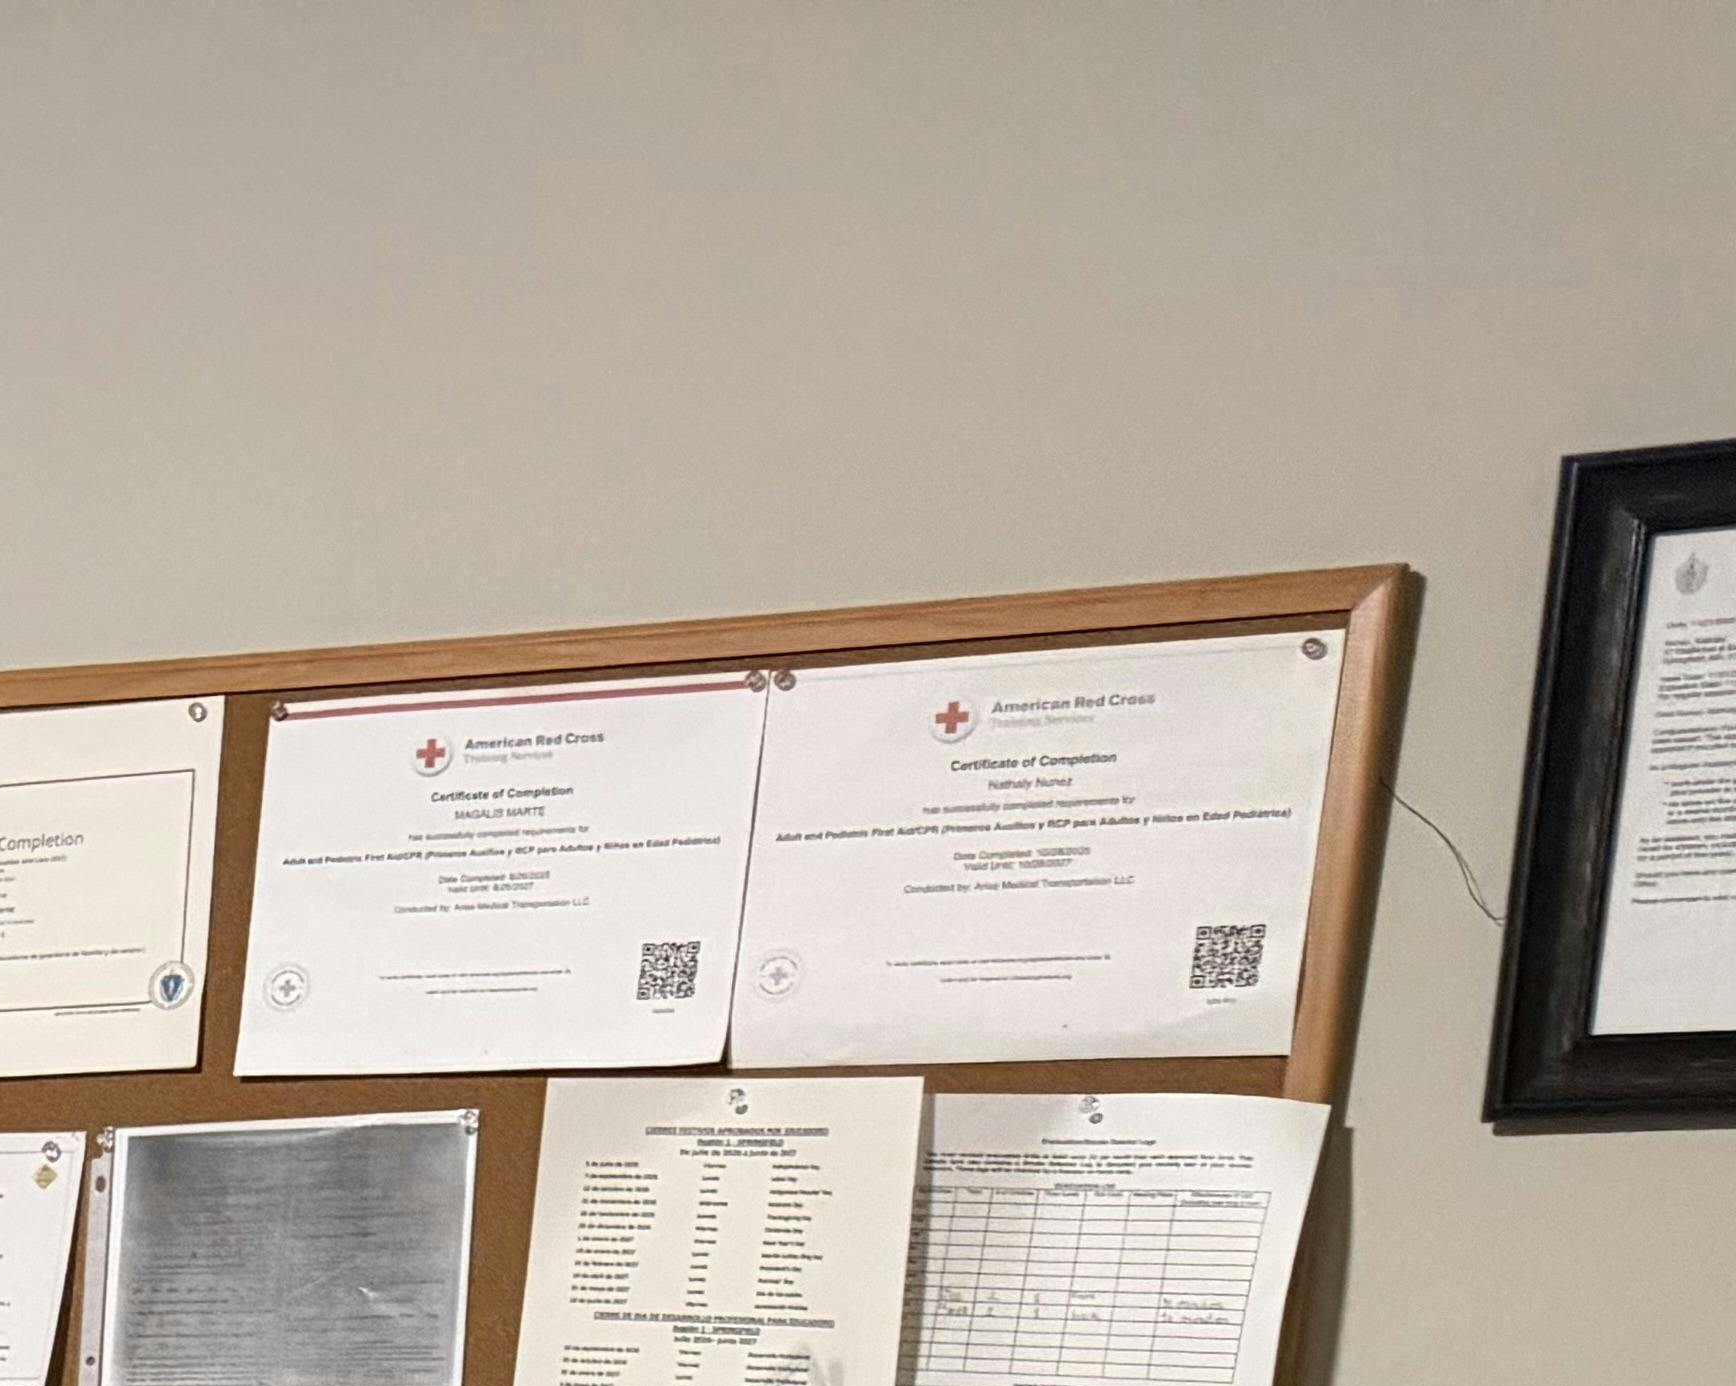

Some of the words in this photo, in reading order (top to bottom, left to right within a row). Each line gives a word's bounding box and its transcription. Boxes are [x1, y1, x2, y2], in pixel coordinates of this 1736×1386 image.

[992, 700, 1070, 713] American
[1074, 697, 1105, 708] Red
[1109, 694, 1156, 706] Cross
[465, 738, 532, 749] American
[536, 735, 562, 746] Red
[565, 732, 604, 744] Cross
[951, 759, 1018, 772] Certificate
[1022, 757, 1036, 767] of
[1039, 754, 1117, 766] Completion
[431, 790, 489, 802] Certificate
[492, 789, 504, 799] of
[507, 787, 574, 798] Completion
[507, 806, 545, 817] MARTE
